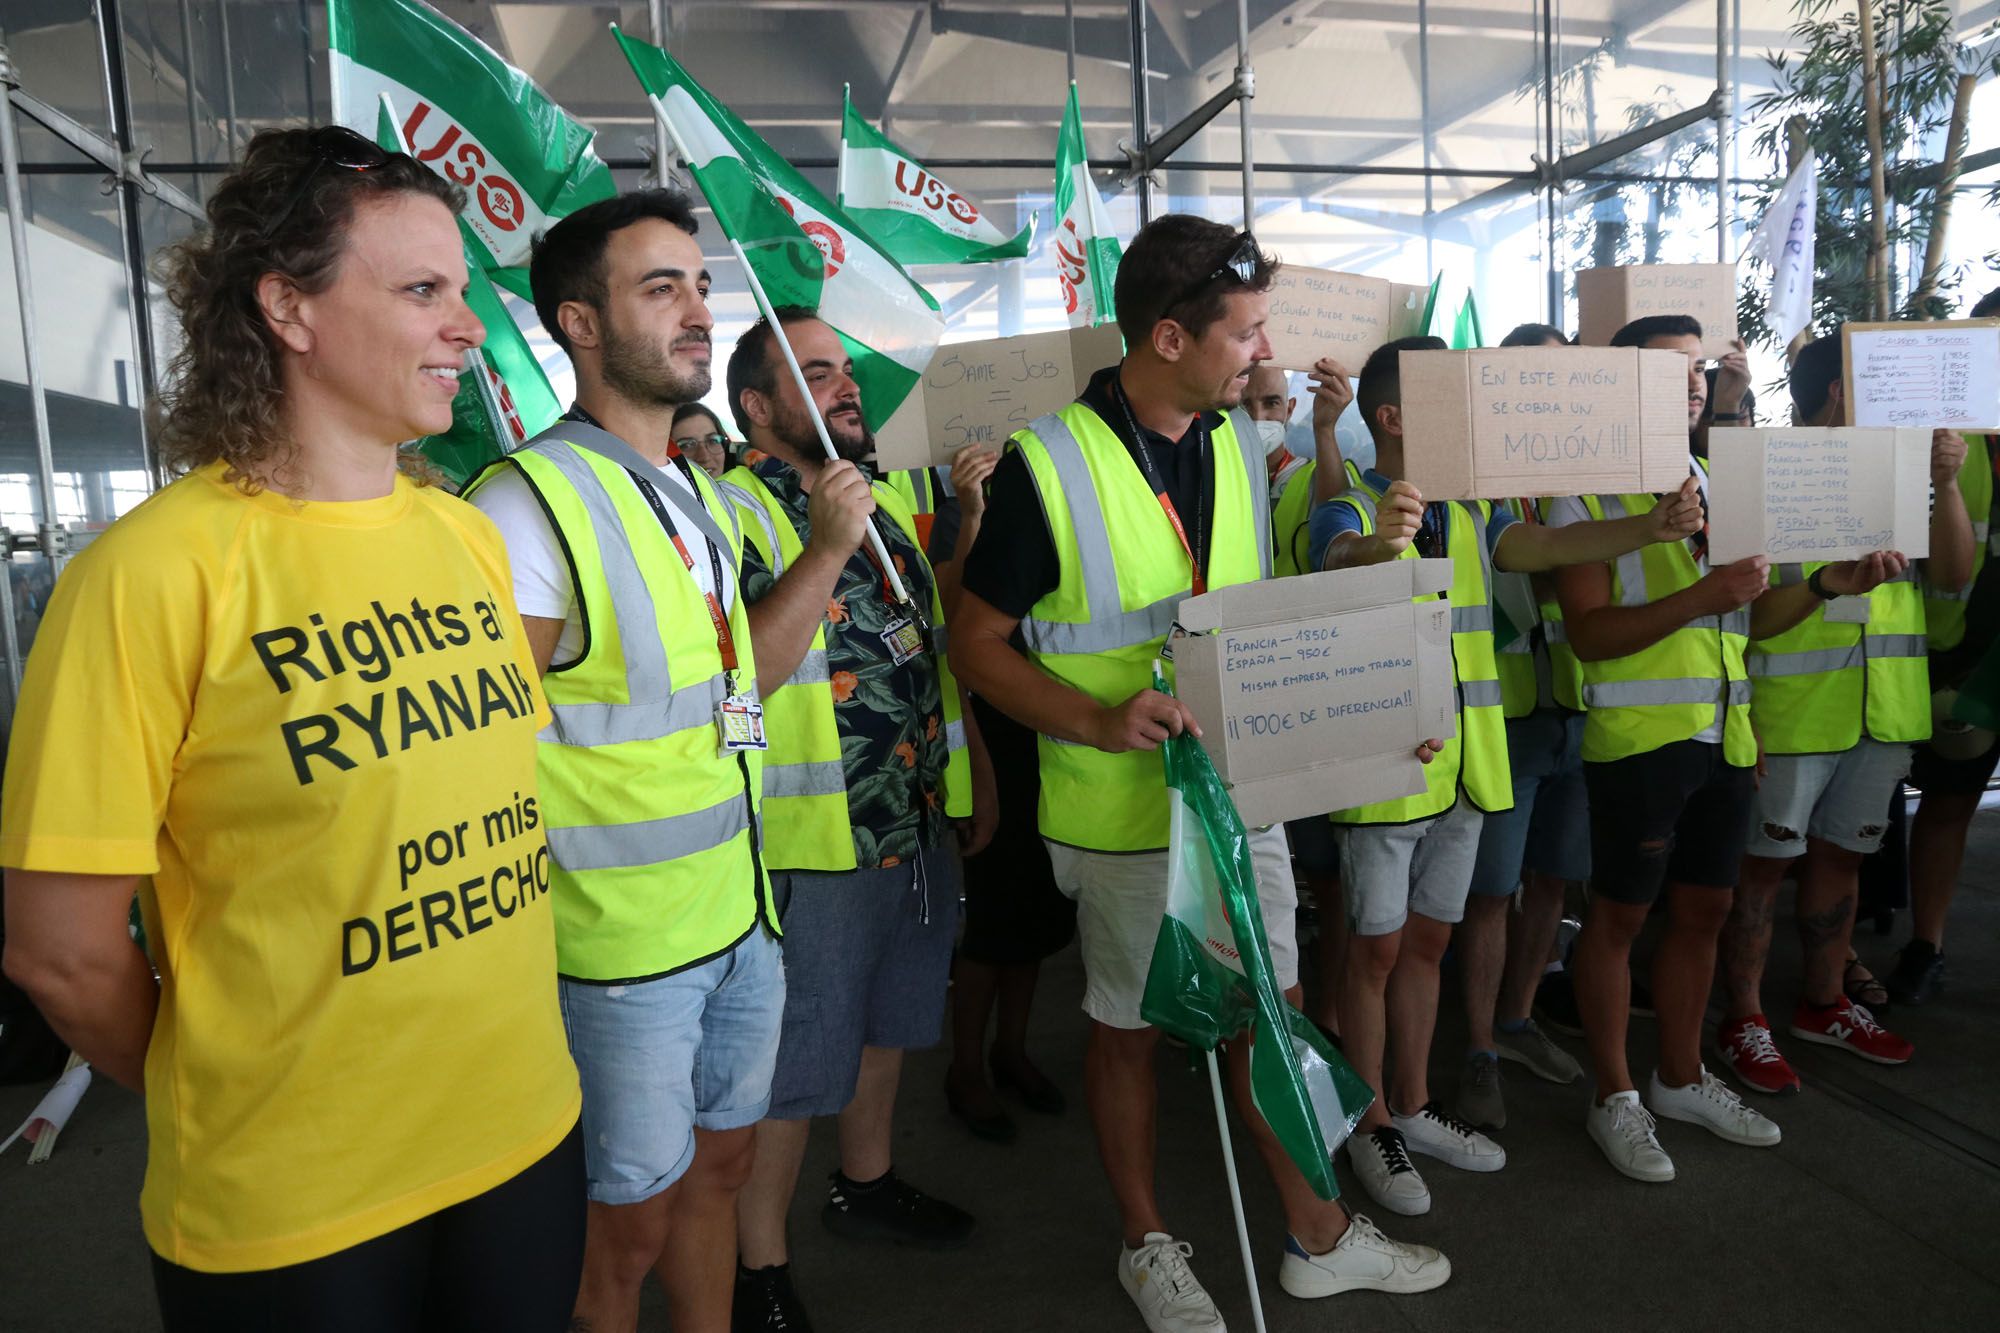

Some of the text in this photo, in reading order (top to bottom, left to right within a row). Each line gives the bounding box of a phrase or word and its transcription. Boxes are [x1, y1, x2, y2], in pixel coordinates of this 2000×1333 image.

[402, 101, 525, 232] USO
[895, 160, 978, 225] USO
[1305, 278, 1334, 293] 950€
[1337, 286, 1350, 295] AL
[1356, 289, 1376, 299] MES
[1317, 308, 1344, 320] PUEDE
[1287, 325, 1368, 342] EL ALQUILER?
[928, 349, 1059, 389] SAME JOB
[1481, 365, 1617, 386] EN ESTE AVIÓN
[1492, 402, 1592, 415] SE COBRA UN
[1942, 407, 1968, 419] 950€
[943, 413, 997, 448] SAME
[1767, 454, 1802, 463] FRANCIA
[1776, 517, 1820, 528] ESPAÑA
[1834, 517, 1864, 528] 950€
[1819, 537, 1837, 548] LOS
[1844, 530, 1895, 547] TONTOS??
[250, 596, 471, 695] Rights
[1226, 638, 1278, 654] FRANCIA
[1295, 627, 1340, 641] 1850€
[1226, 654, 1275, 672] ESPAÑA
[1297, 647, 1331, 661] 950€
[1241, 658, 1413, 692] MISMA EMPRESA, MISMO TRABAJO
[1300, 709, 1317, 724] DE
[1327, 689, 1413, 719] DIFERENCIA!!
[398, 791, 539, 892] por mis
